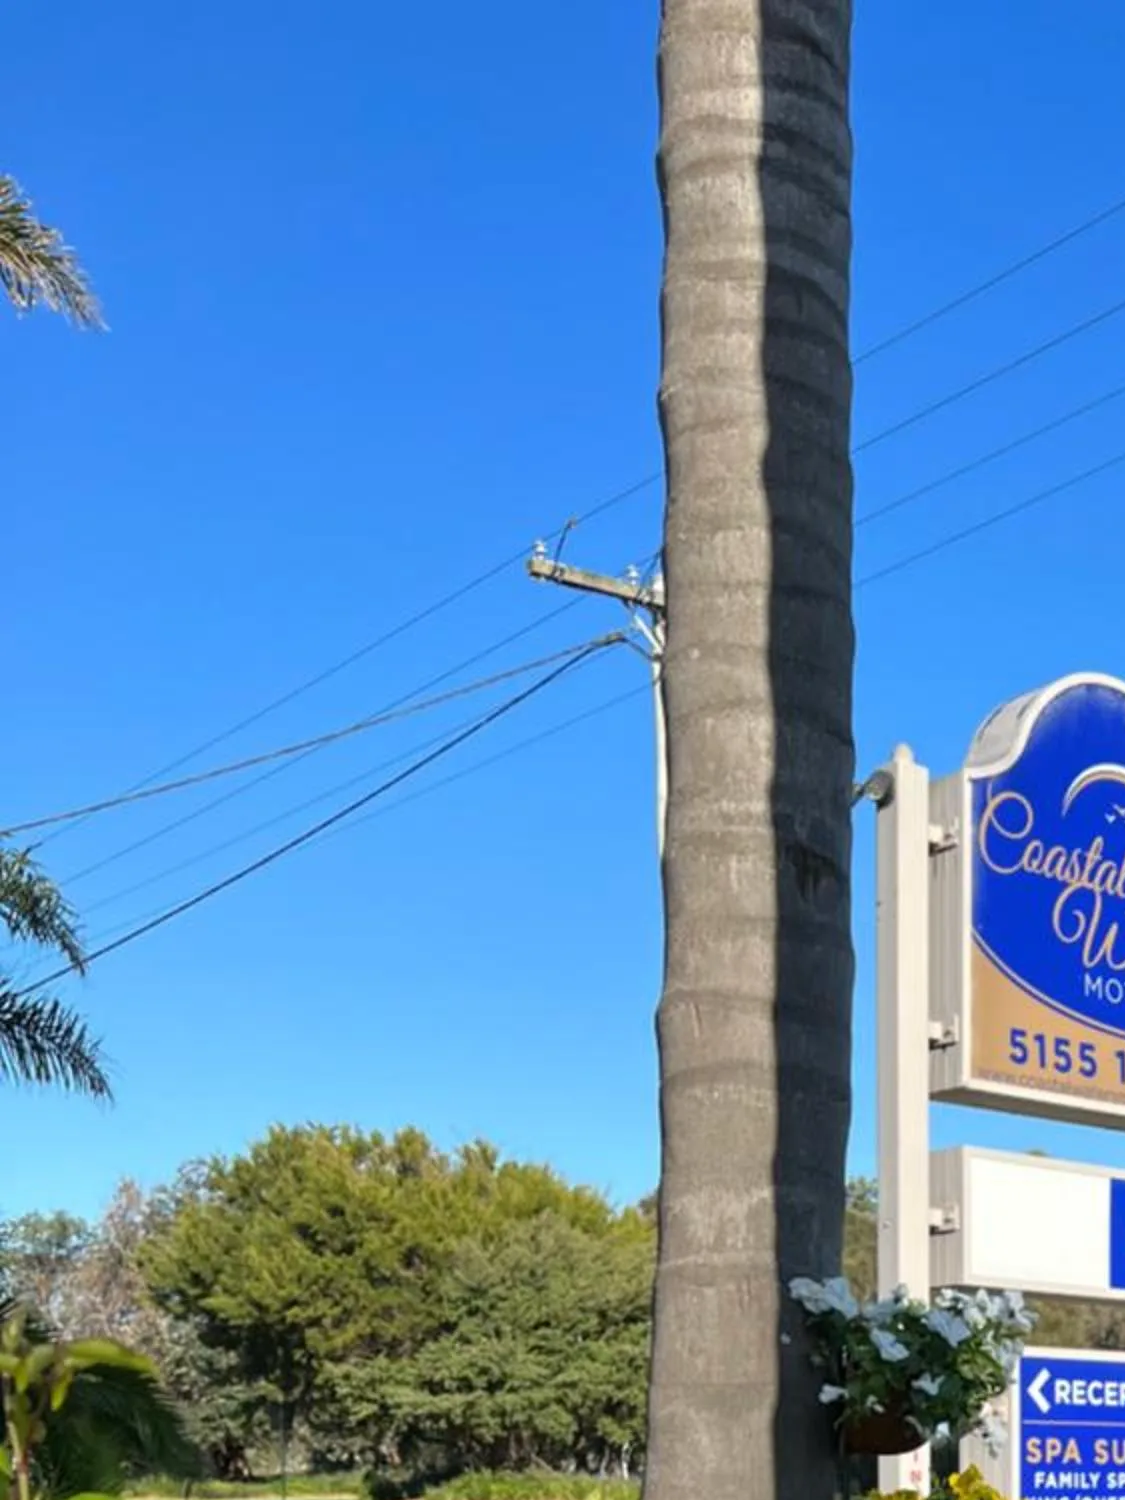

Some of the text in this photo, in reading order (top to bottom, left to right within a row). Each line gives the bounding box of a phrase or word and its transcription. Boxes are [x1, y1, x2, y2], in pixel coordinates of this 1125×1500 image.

[1009, 1028, 1098, 1079] 5155
[1026, 1437, 1082, 1465] SPA
[1034, 1471, 1101, 1490] FAMILY
